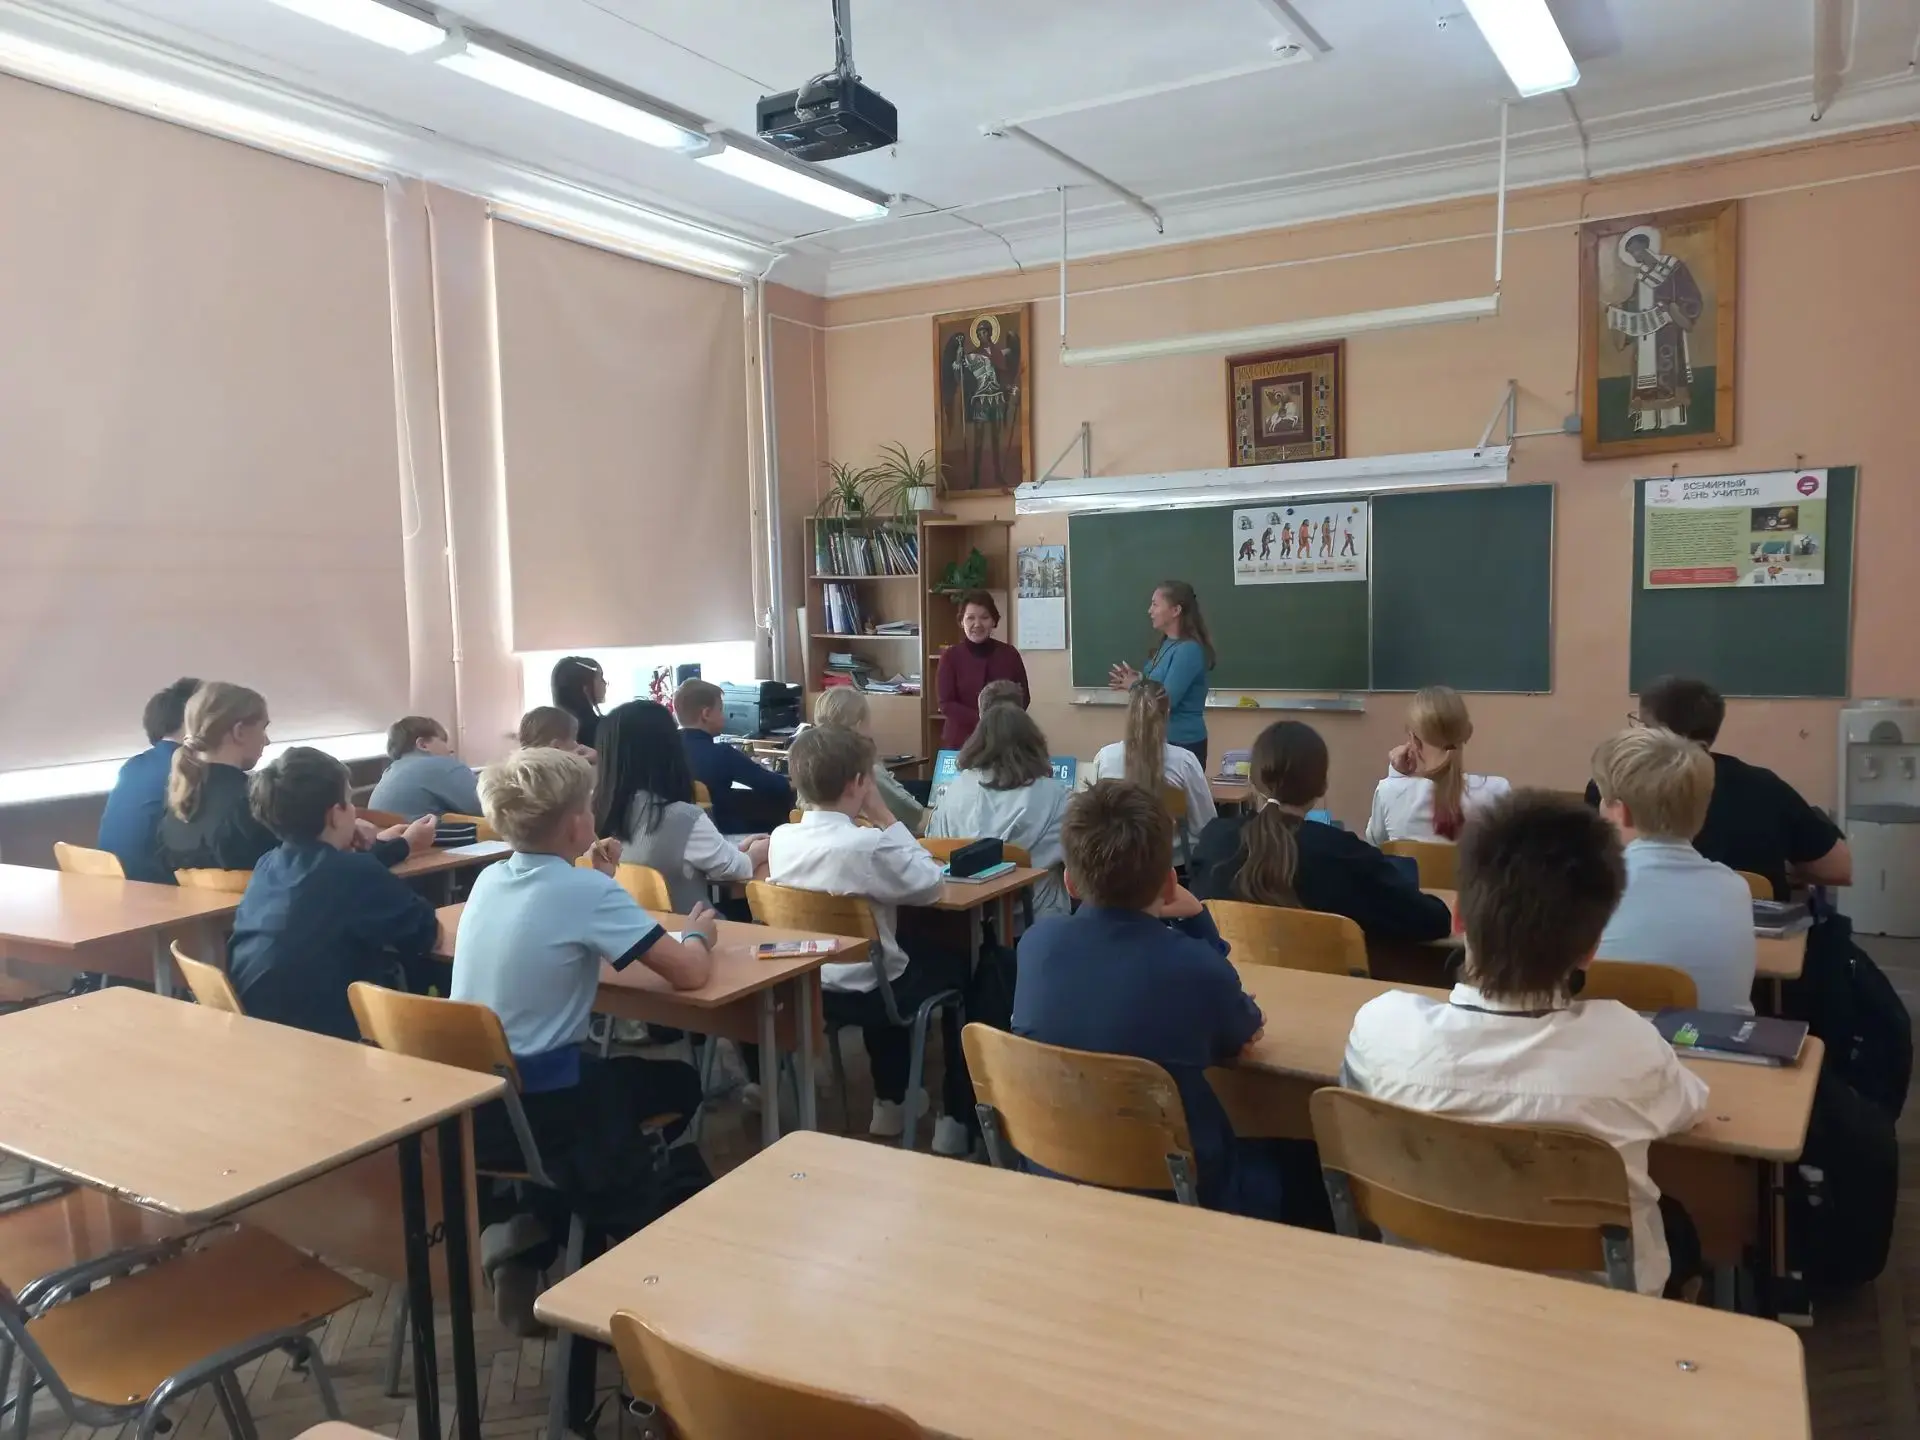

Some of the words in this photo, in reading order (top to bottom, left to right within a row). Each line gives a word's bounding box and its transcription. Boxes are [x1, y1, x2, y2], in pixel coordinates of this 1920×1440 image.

[1659, 484, 1669, 498] 5
[1683, 479, 1746, 491] ВСЕМИРНЫЙ
[1683, 491, 1708, 500] ДЕНЬ
[1712, 487, 1760, 498] УЧИТЕЛЯ
[1060, 765, 1068, 779] 6
